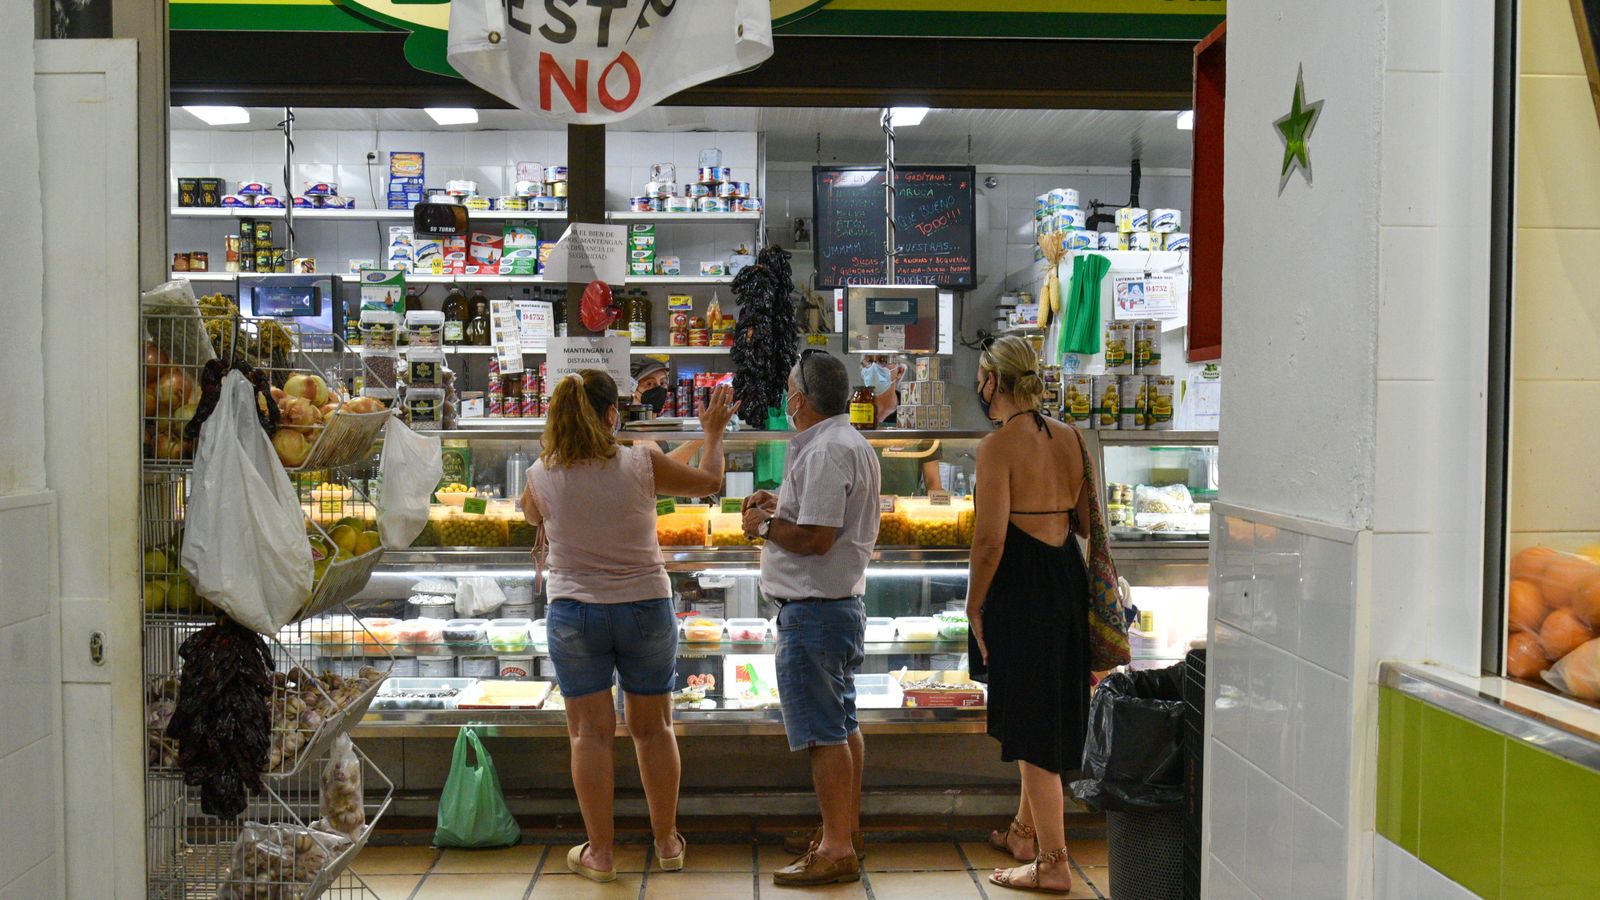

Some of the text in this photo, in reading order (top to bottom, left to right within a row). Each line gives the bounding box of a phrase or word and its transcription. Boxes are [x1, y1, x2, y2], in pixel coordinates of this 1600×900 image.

[539, 50, 642, 114] NO
[919, 194, 956, 218] BUENO
[580, 238, 624, 246] MANTENGAN
[570, 244, 606, 253] DISTANCIA
[569, 252, 607, 261] SEGURIDAD
